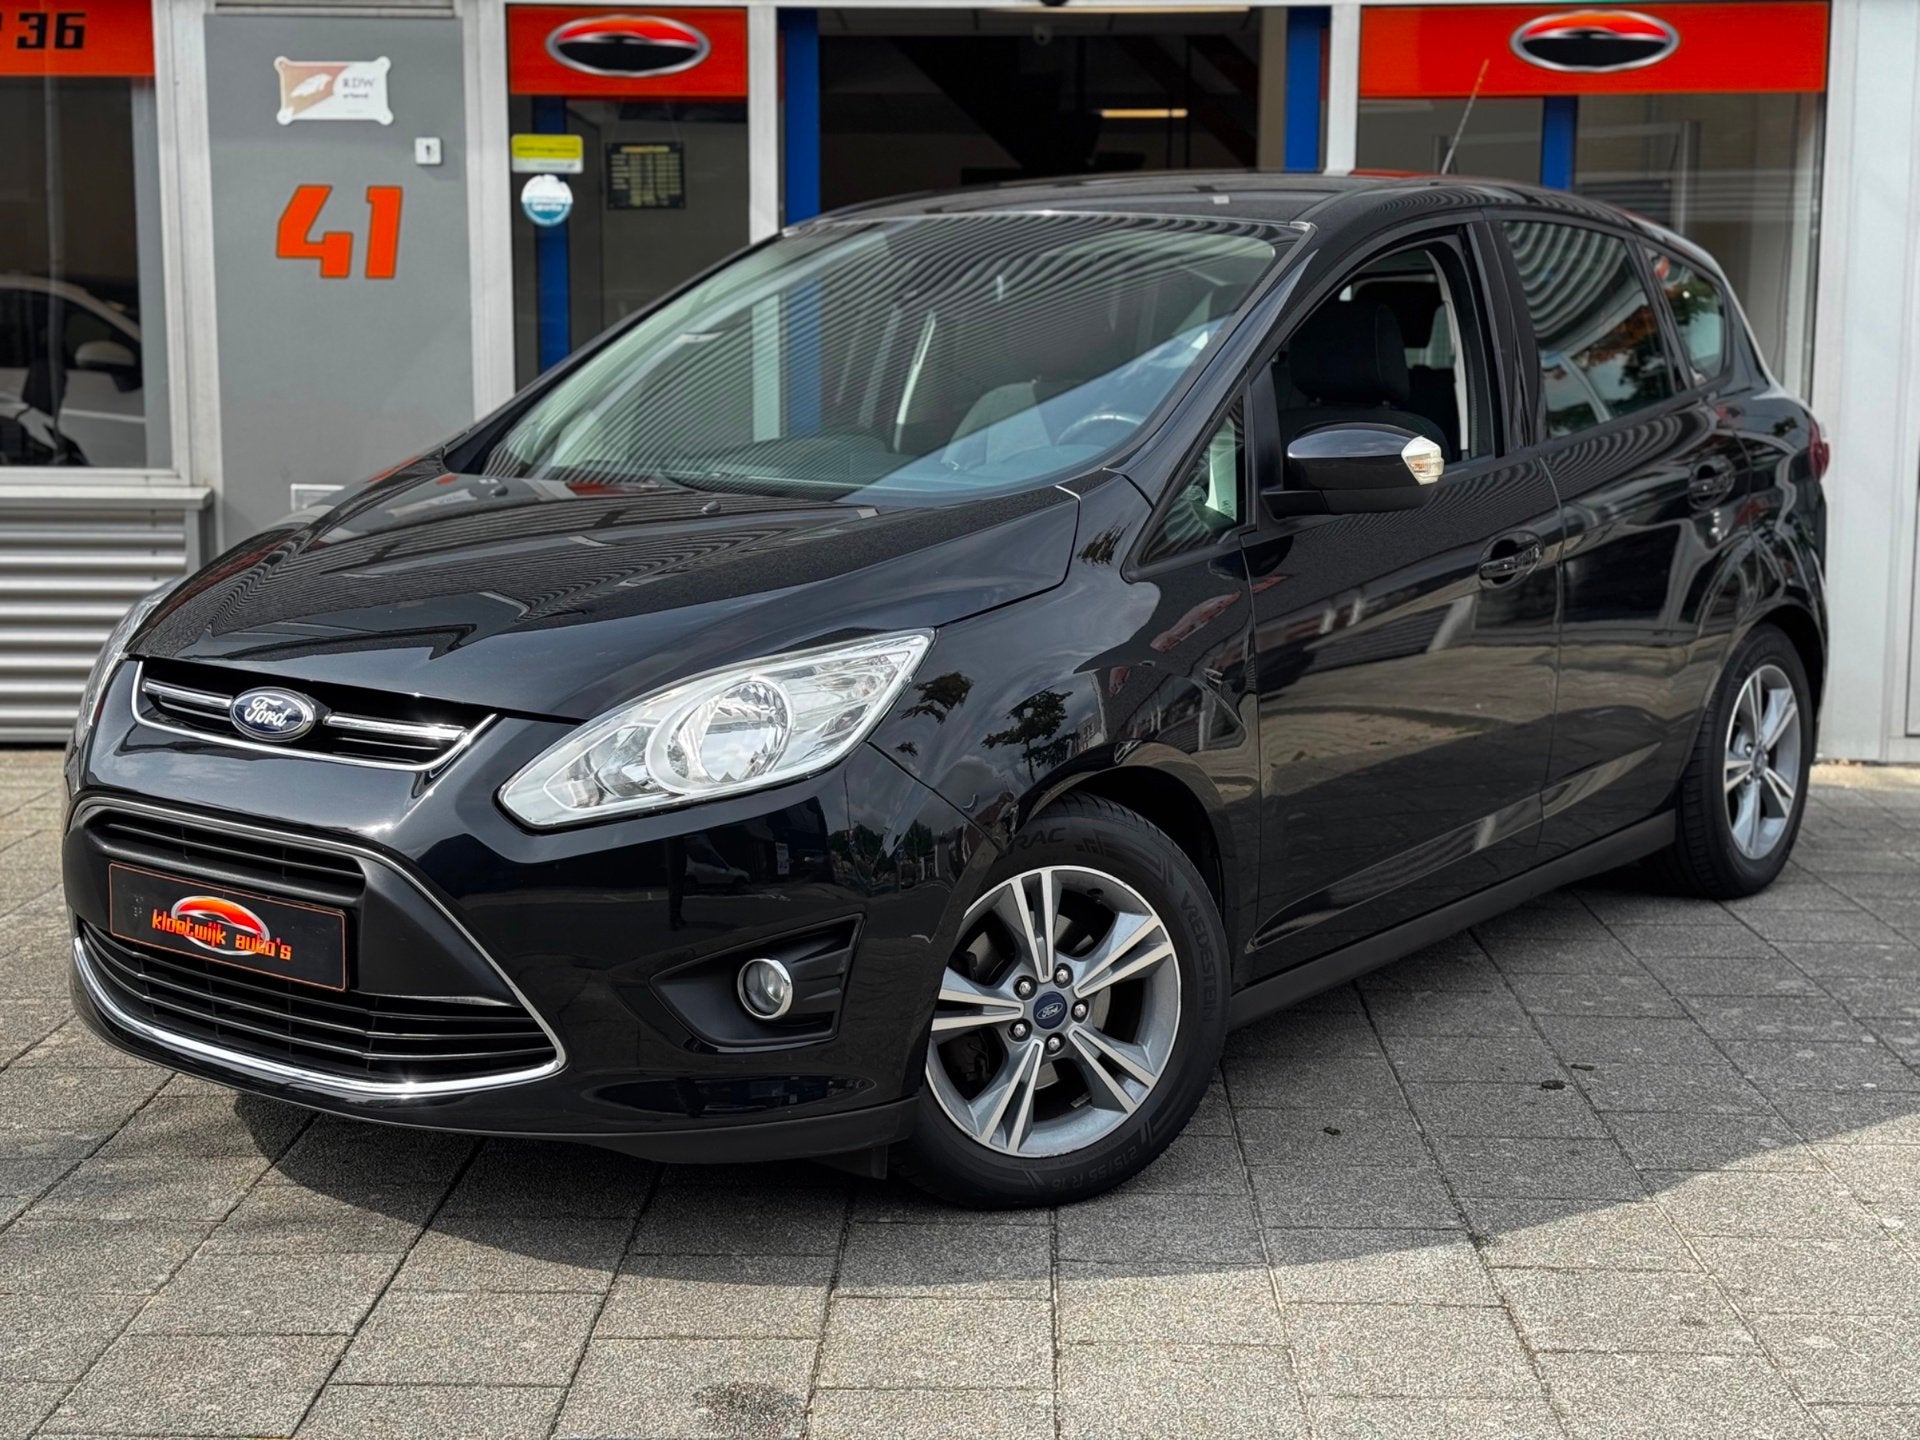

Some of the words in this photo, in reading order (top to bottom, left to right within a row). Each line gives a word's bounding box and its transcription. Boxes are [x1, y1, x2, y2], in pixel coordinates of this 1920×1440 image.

[16, 12, 87, 50] 36
[343, 77, 376, 89] RDW
[276, 184, 403, 280] 41
[244, 695, 292, 727] Ford
[152, 908, 227, 948] klootwijk
[234, 931, 292, 962] auto's
